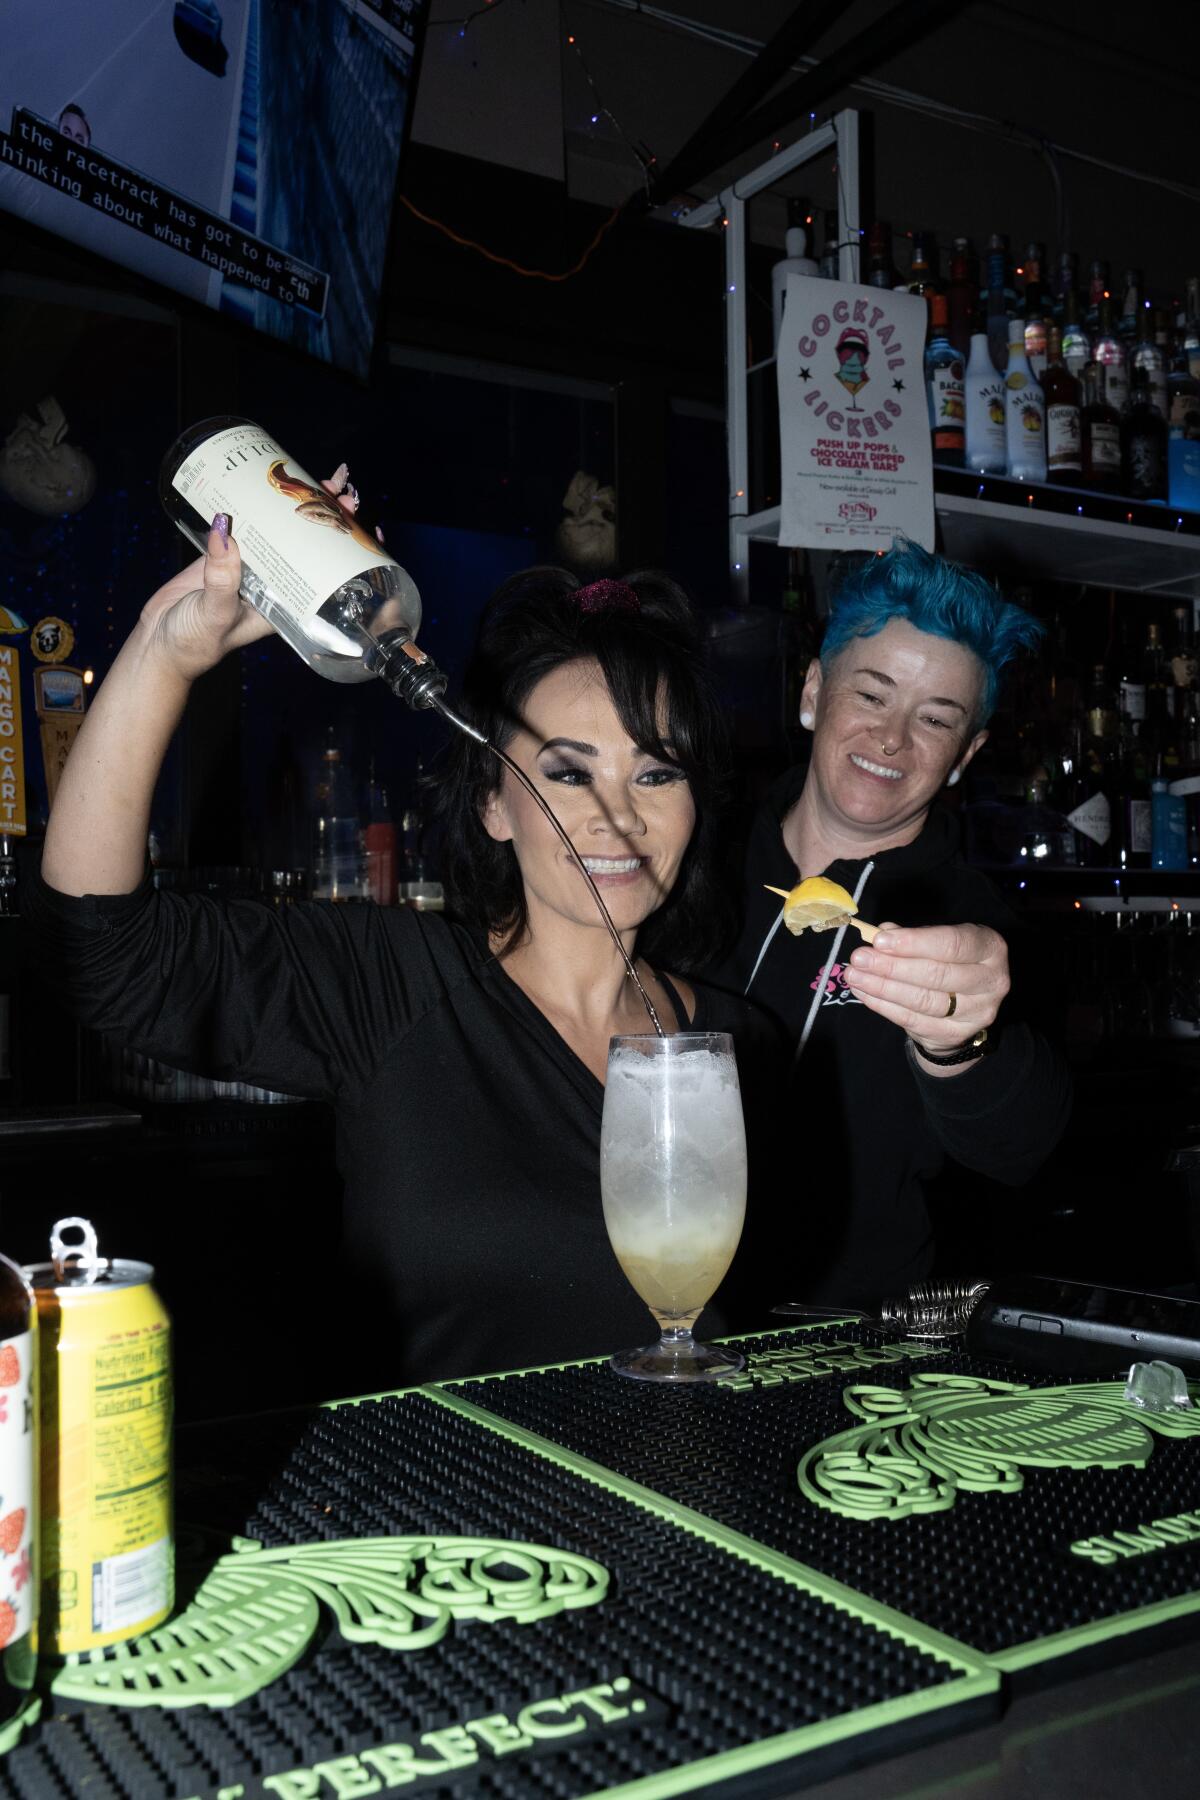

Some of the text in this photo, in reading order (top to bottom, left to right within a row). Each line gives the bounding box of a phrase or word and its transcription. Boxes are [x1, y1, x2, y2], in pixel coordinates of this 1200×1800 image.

[19, 121, 282, 273] the racetrack has got to be
[93, 191, 145, 228] about
[154, 223, 193, 252] what
[201, 243, 271, 291] happened
[278, 285, 295, 303] to
[798, 299, 906, 372] COCKTAIL
[803, 390, 903, 439] LICKERS
[810, 448, 905, 464] CHOCOLATE DIPPED
[817, 439, 844, 449] PUSH
[847, 441, 860, 450] UP
[863, 443, 889, 453] POPS
[817, 458, 899, 472] ICE CREAM BARS
[0, 746, 17, 820] CART
